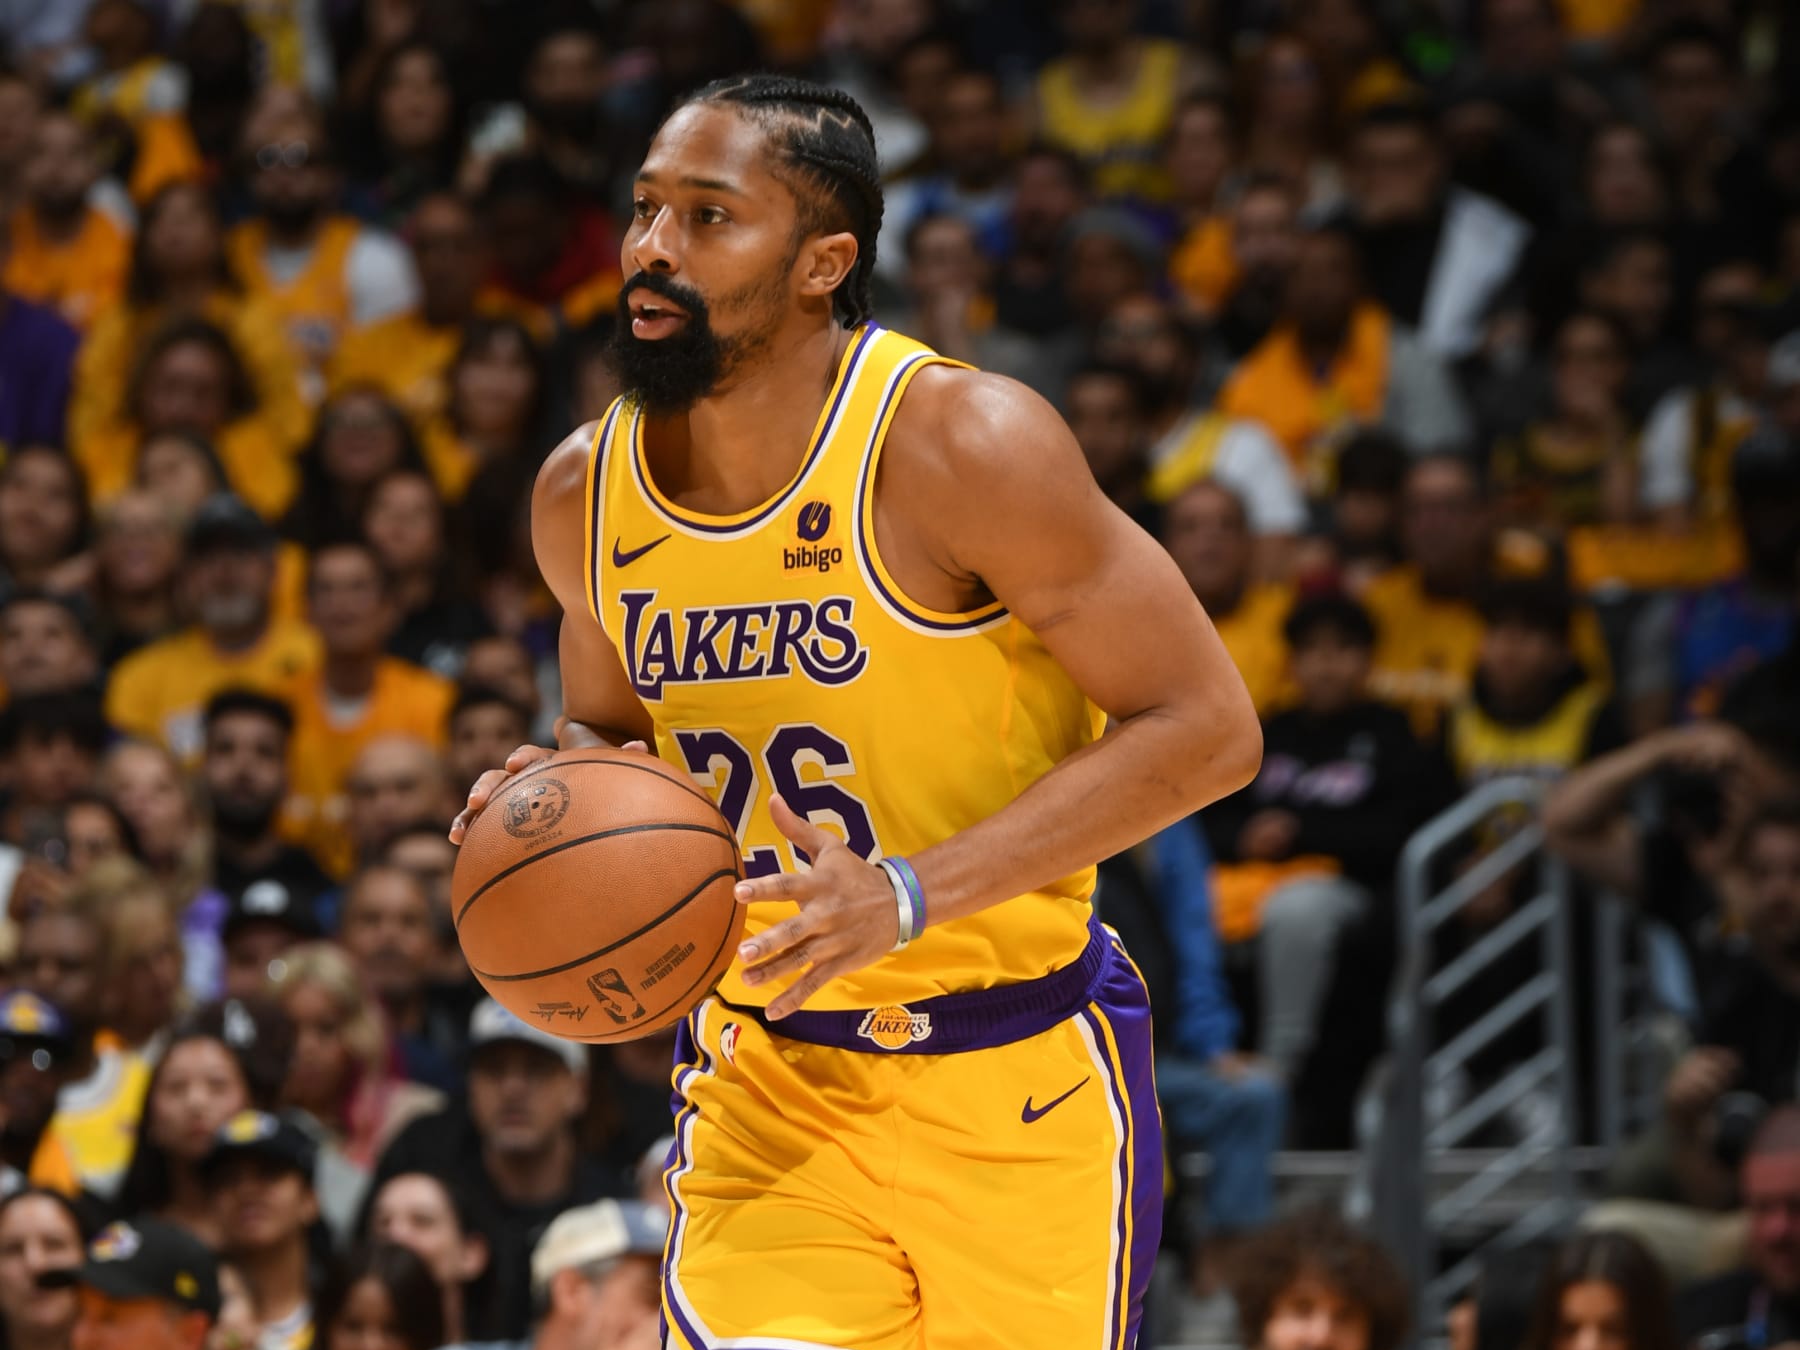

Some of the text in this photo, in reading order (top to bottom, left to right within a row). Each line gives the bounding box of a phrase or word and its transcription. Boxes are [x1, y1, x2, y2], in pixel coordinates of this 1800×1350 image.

[782, 545, 843, 572] bibigo
[618, 589, 870, 704] LAKERS
[672, 722, 883, 880] 26
[861, 1012, 932, 1040] LAKERS
